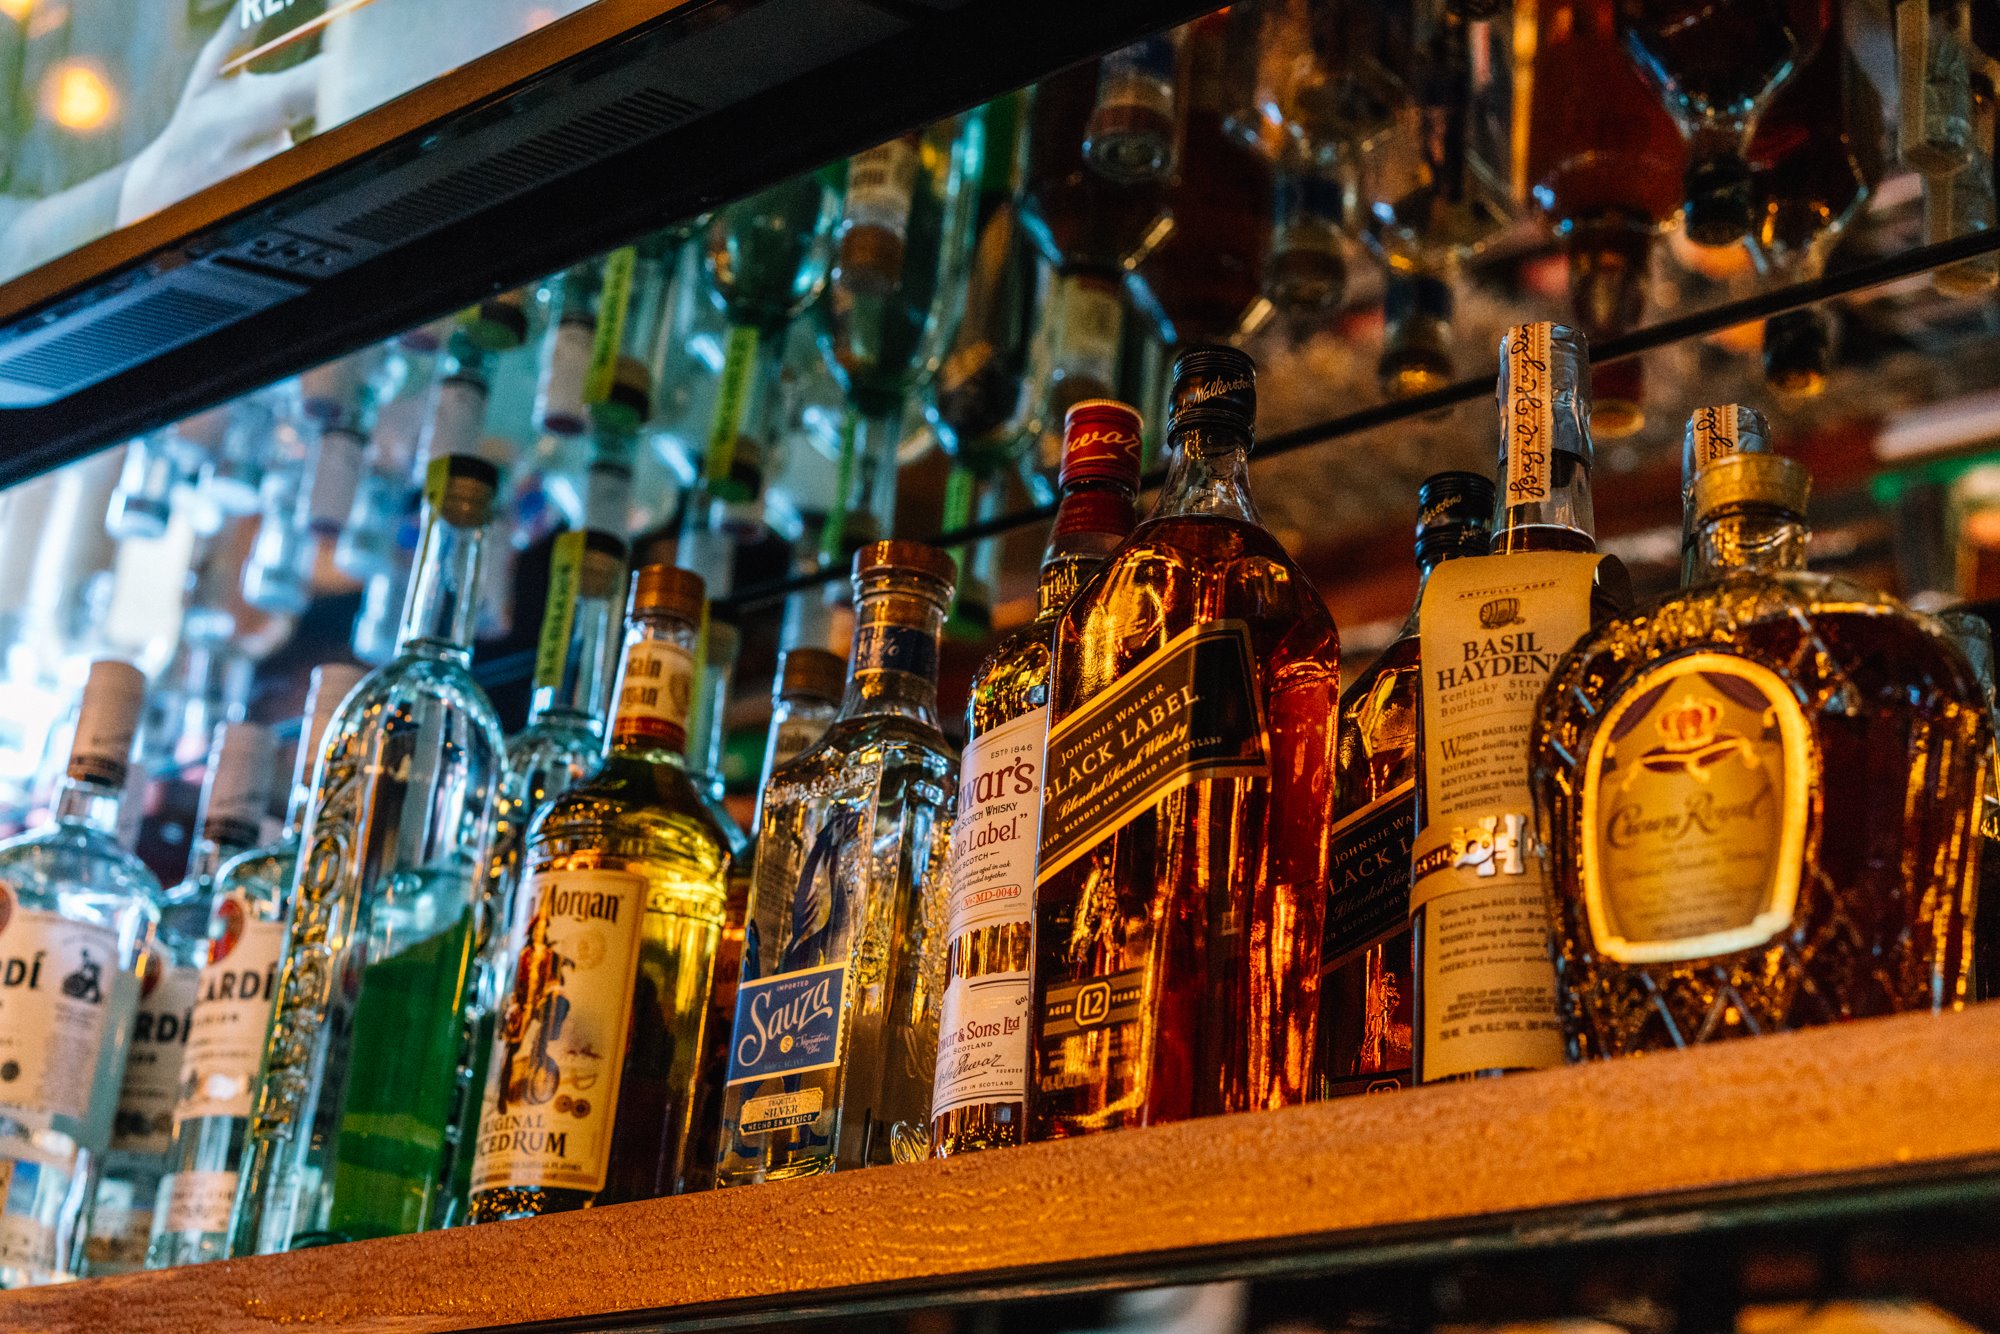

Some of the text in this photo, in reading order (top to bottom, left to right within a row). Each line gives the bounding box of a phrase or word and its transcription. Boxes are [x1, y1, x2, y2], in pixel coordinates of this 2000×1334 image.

[1462, 631, 1543, 664] BASIL
[1441, 682, 1498, 704] Kentucky
[1119, 684, 1199, 749] LABEL
[1441, 697, 1494, 718] Bourbon
[1060, 683, 1165, 767] JOHNNIE WALKER
[1010, 743, 1033, 755] 1846
[1056, 774, 1106, 822] Blended
[1143, 720, 1188, 757] Whisky
[1064, 803, 1101, 833] BLENDED
[1102, 790, 1120, 807] AND
[1121, 765, 1157, 793] BOTTLED
[1159, 755, 1171, 766] IN
[1172, 735, 1223, 757] SCOTLAND
[985, 802, 1018, 817] WHISKY
[1334, 827, 1390, 869] JOHNNIE
[962, 852, 989, 868] SCOTCH
[776, 979, 809, 992] IMPORTED
[1048, 990, 1142, 1017] AGED 12 YEARS
[737, 977, 834, 1067] Sauza
[966, 1020, 1001, 1041] Sons
[1003, 1015, 1021, 1036] Ltd
[953, 1041, 993, 1055] SCOTLAND
[995, 1067, 1024, 1075] FOUNDER
[979, 1080, 1014, 1088] SCOTLAND
[763, 1104, 799, 1119] SILVER
[747, 1121, 772, 1131] HECHO
[773, 1119, 783, 1127] EN
